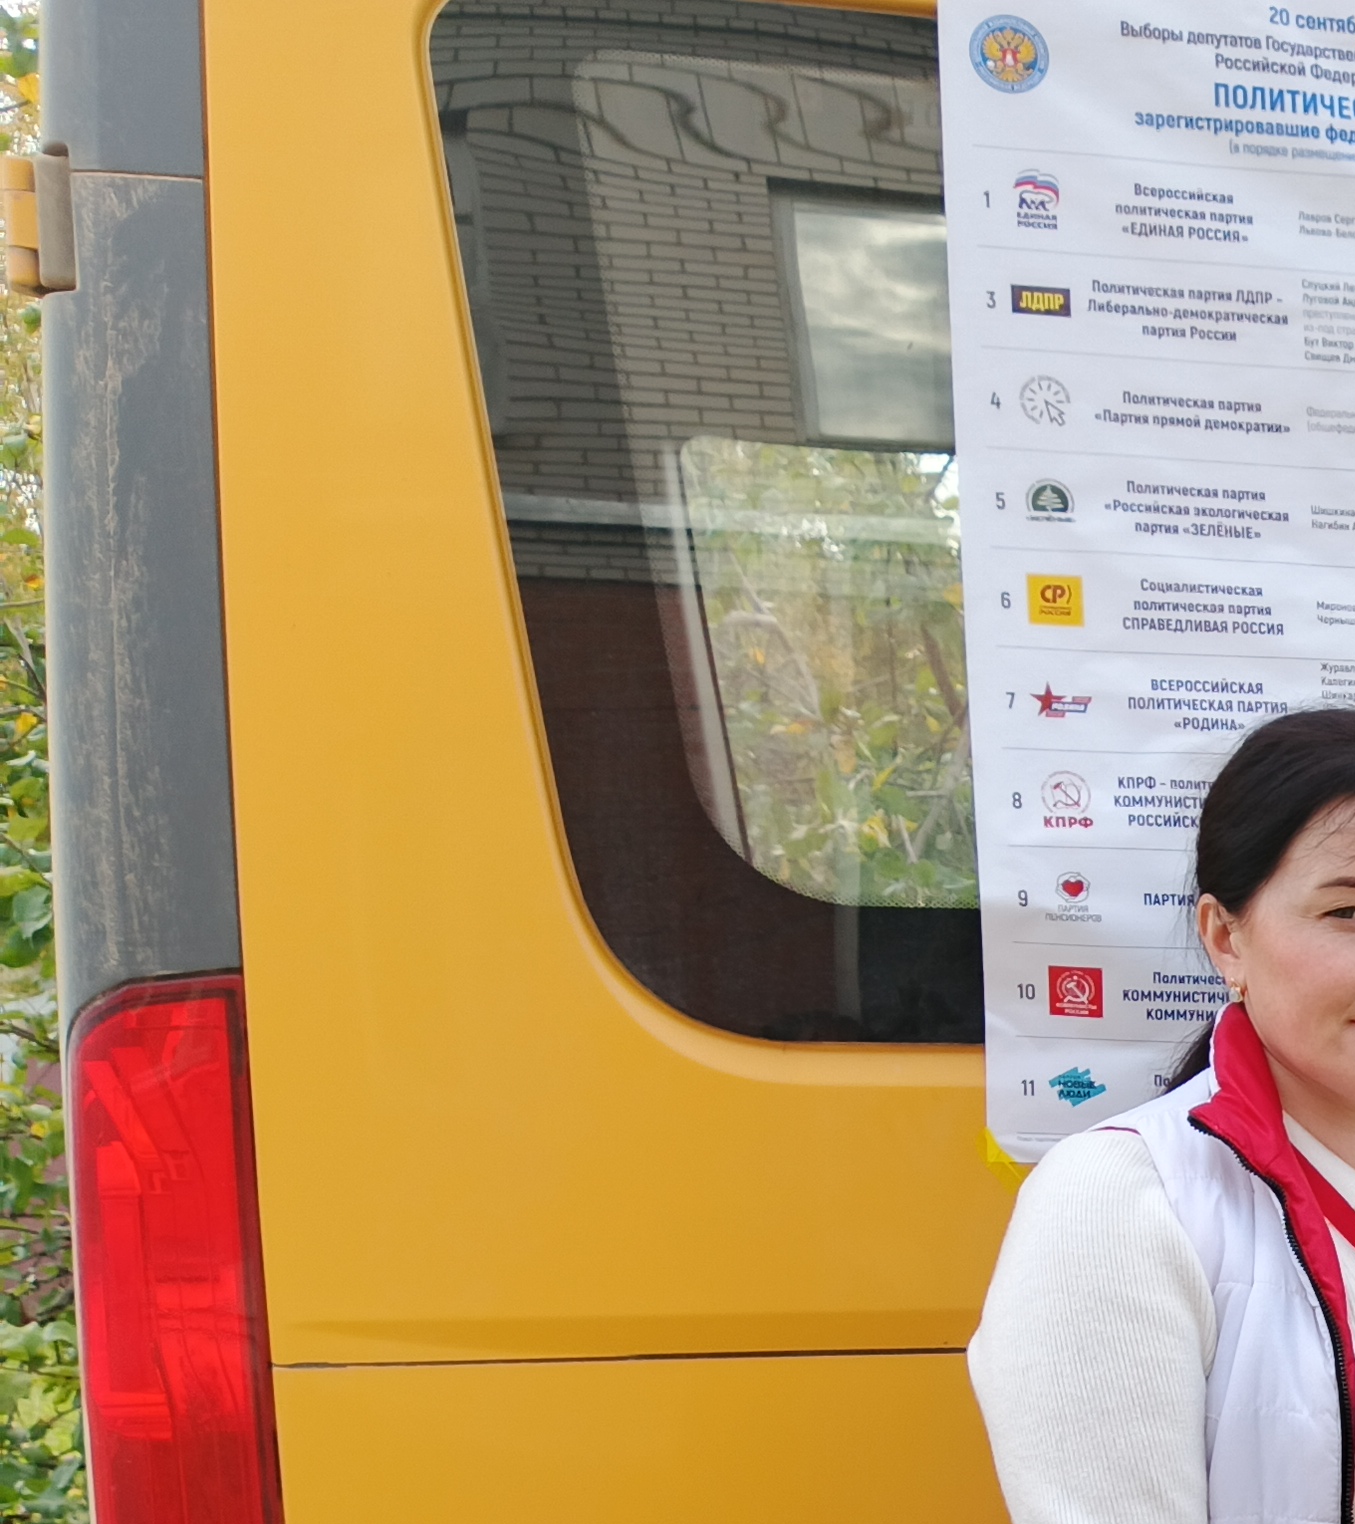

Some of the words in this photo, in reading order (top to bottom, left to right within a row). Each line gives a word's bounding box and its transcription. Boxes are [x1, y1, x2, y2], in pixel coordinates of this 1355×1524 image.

[1269, 6, 1289, 25] 20
[1120, 20, 1182, 45] Выборы
[1186, 30, 1261, 53] депутатов
[1215, 52, 1305, 76] Российской
[1135, 109, 1319, 144] зарегистрировавшие
[984, 192, 990, 207] 1
[1134, 183, 1233, 205] Всероссийская
[1115, 204, 1205, 220] политическая
[1210, 212, 1252, 226] партия
[1122, 221, 1183, 238] «ЕДИНАЯ
[1188, 226, 1247, 242] РОССИЯ»
[987, 291, 996, 308] 3
[1019, 291, 1064, 310] ЛДПР
[1092, 279, 1184, 298] Политическая
[1188, 289, 1231, 304] партия
[1235, 289, 1272, 306] ЛДПР
[1088, 299, 1287, 326] Либерально-демократическая
[1142, 325, 1185, 340] партия
[1190, 326, 1236, 341] России
[991, 392, 1001, 409] 4
[1123, 391, 1214, 409] Политическая
[1218, 400, 1261, 415] партия
[1095, 408, 1148, 426] «Партия
[1152, 415, 1200, 429] прямой
[1204, 419, 1289, 435] демократии»
[1126, 480, 1218, 498] Политическая
[1222, 489, 1264, 503] партия
[996, 493, 1005, 510] 5
[1104, 499, 1189, 515] «Российская
[1194, 507, 1288, 521] экологическая
[1135, 522, 1178, 536] партия
[1183, 523, 1260, 539] «ЗЕЛЁНЫЕ»
[1140, 578, 1262, 597] Социалистическая
[1001, 592, 1011, 609] 6
[1134, 600, 1223, 613] политическая
[1228, 604, 1271, 617] партия
[1122, 616, 1227, 634] СПРАВЕДЛИВАЯ
[1232, 621, 1283, 635] РОССИЯ
[1151, 678, 1262, 694] ВСЕРОССИЙСКАЯ
[1006, 692, 1015, 708] 7
[1128, 696, 1232, 711] ПОЛИТИЧЕСКАЯ
[1237, 700, 1290, 717] ПАРТИЯ
[1174, 718, 1245, 731] «РОДИНА»
[1118, 777, 1156, 789] КПРФ
[1012, 792, 1022, 808] 8
[1044, 816, 1093, 828] КПРФ
[1018, 890, 1028, 907] 9
[1144, 893, 1195, 906] ПАРТИЯ
[1017, 984, 1035, 1000] 10
[1022, 1080, 1034, 1096] 11
